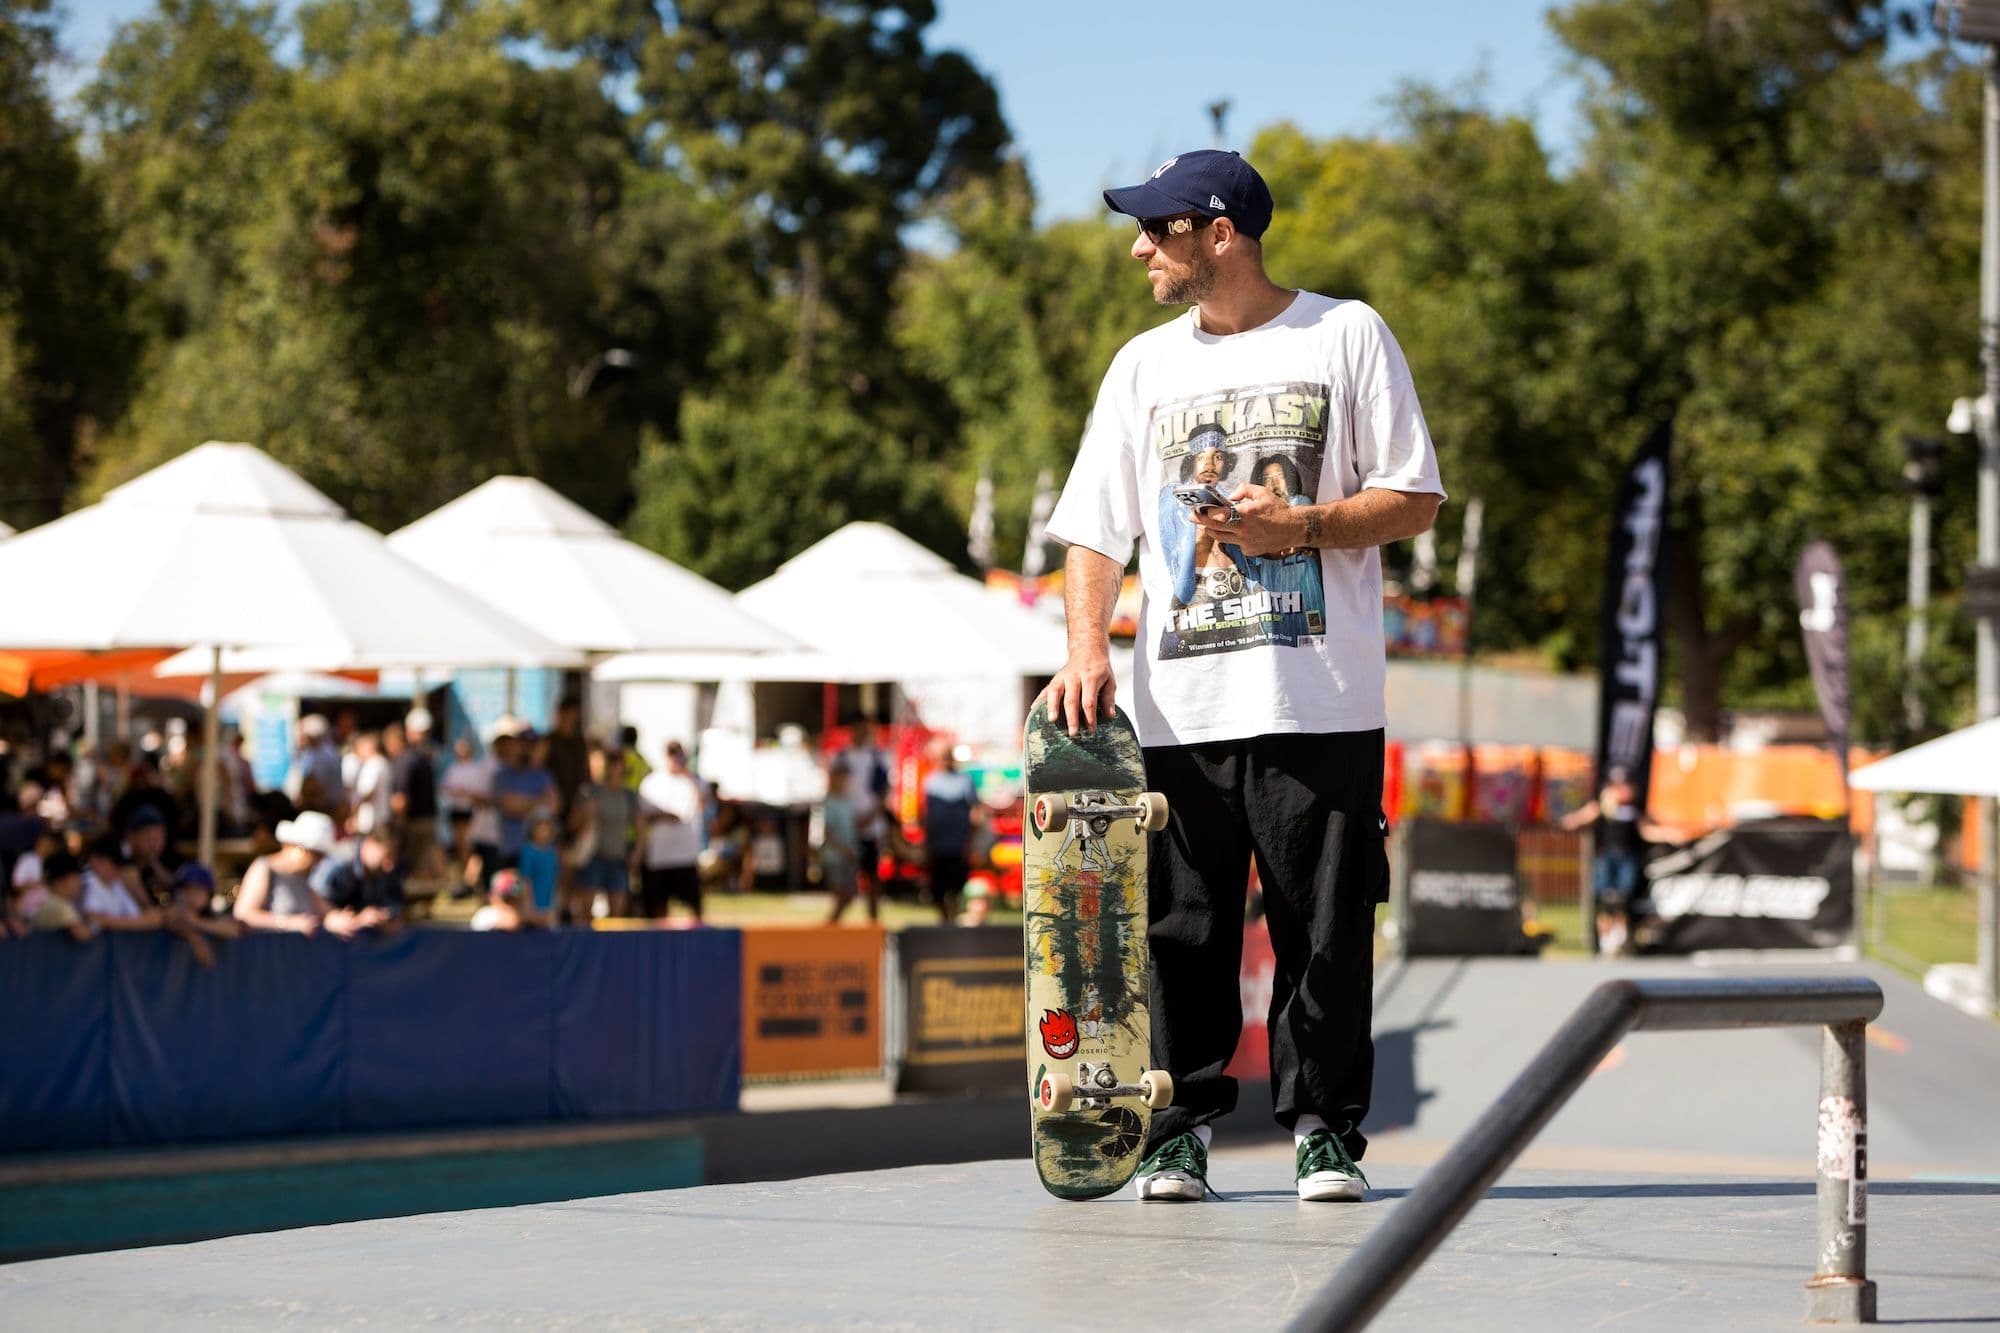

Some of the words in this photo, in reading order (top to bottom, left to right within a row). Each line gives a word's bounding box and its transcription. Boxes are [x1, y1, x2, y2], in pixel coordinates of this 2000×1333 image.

[1156, 394, 1326, 449] OUTKAST
[1165, 602, 1216, 633] THE
[1222, 591, 1303, 621] SOUTH
[1188, 642, 1216, 651] Winners
[1225, 639, 1236, 647] the
